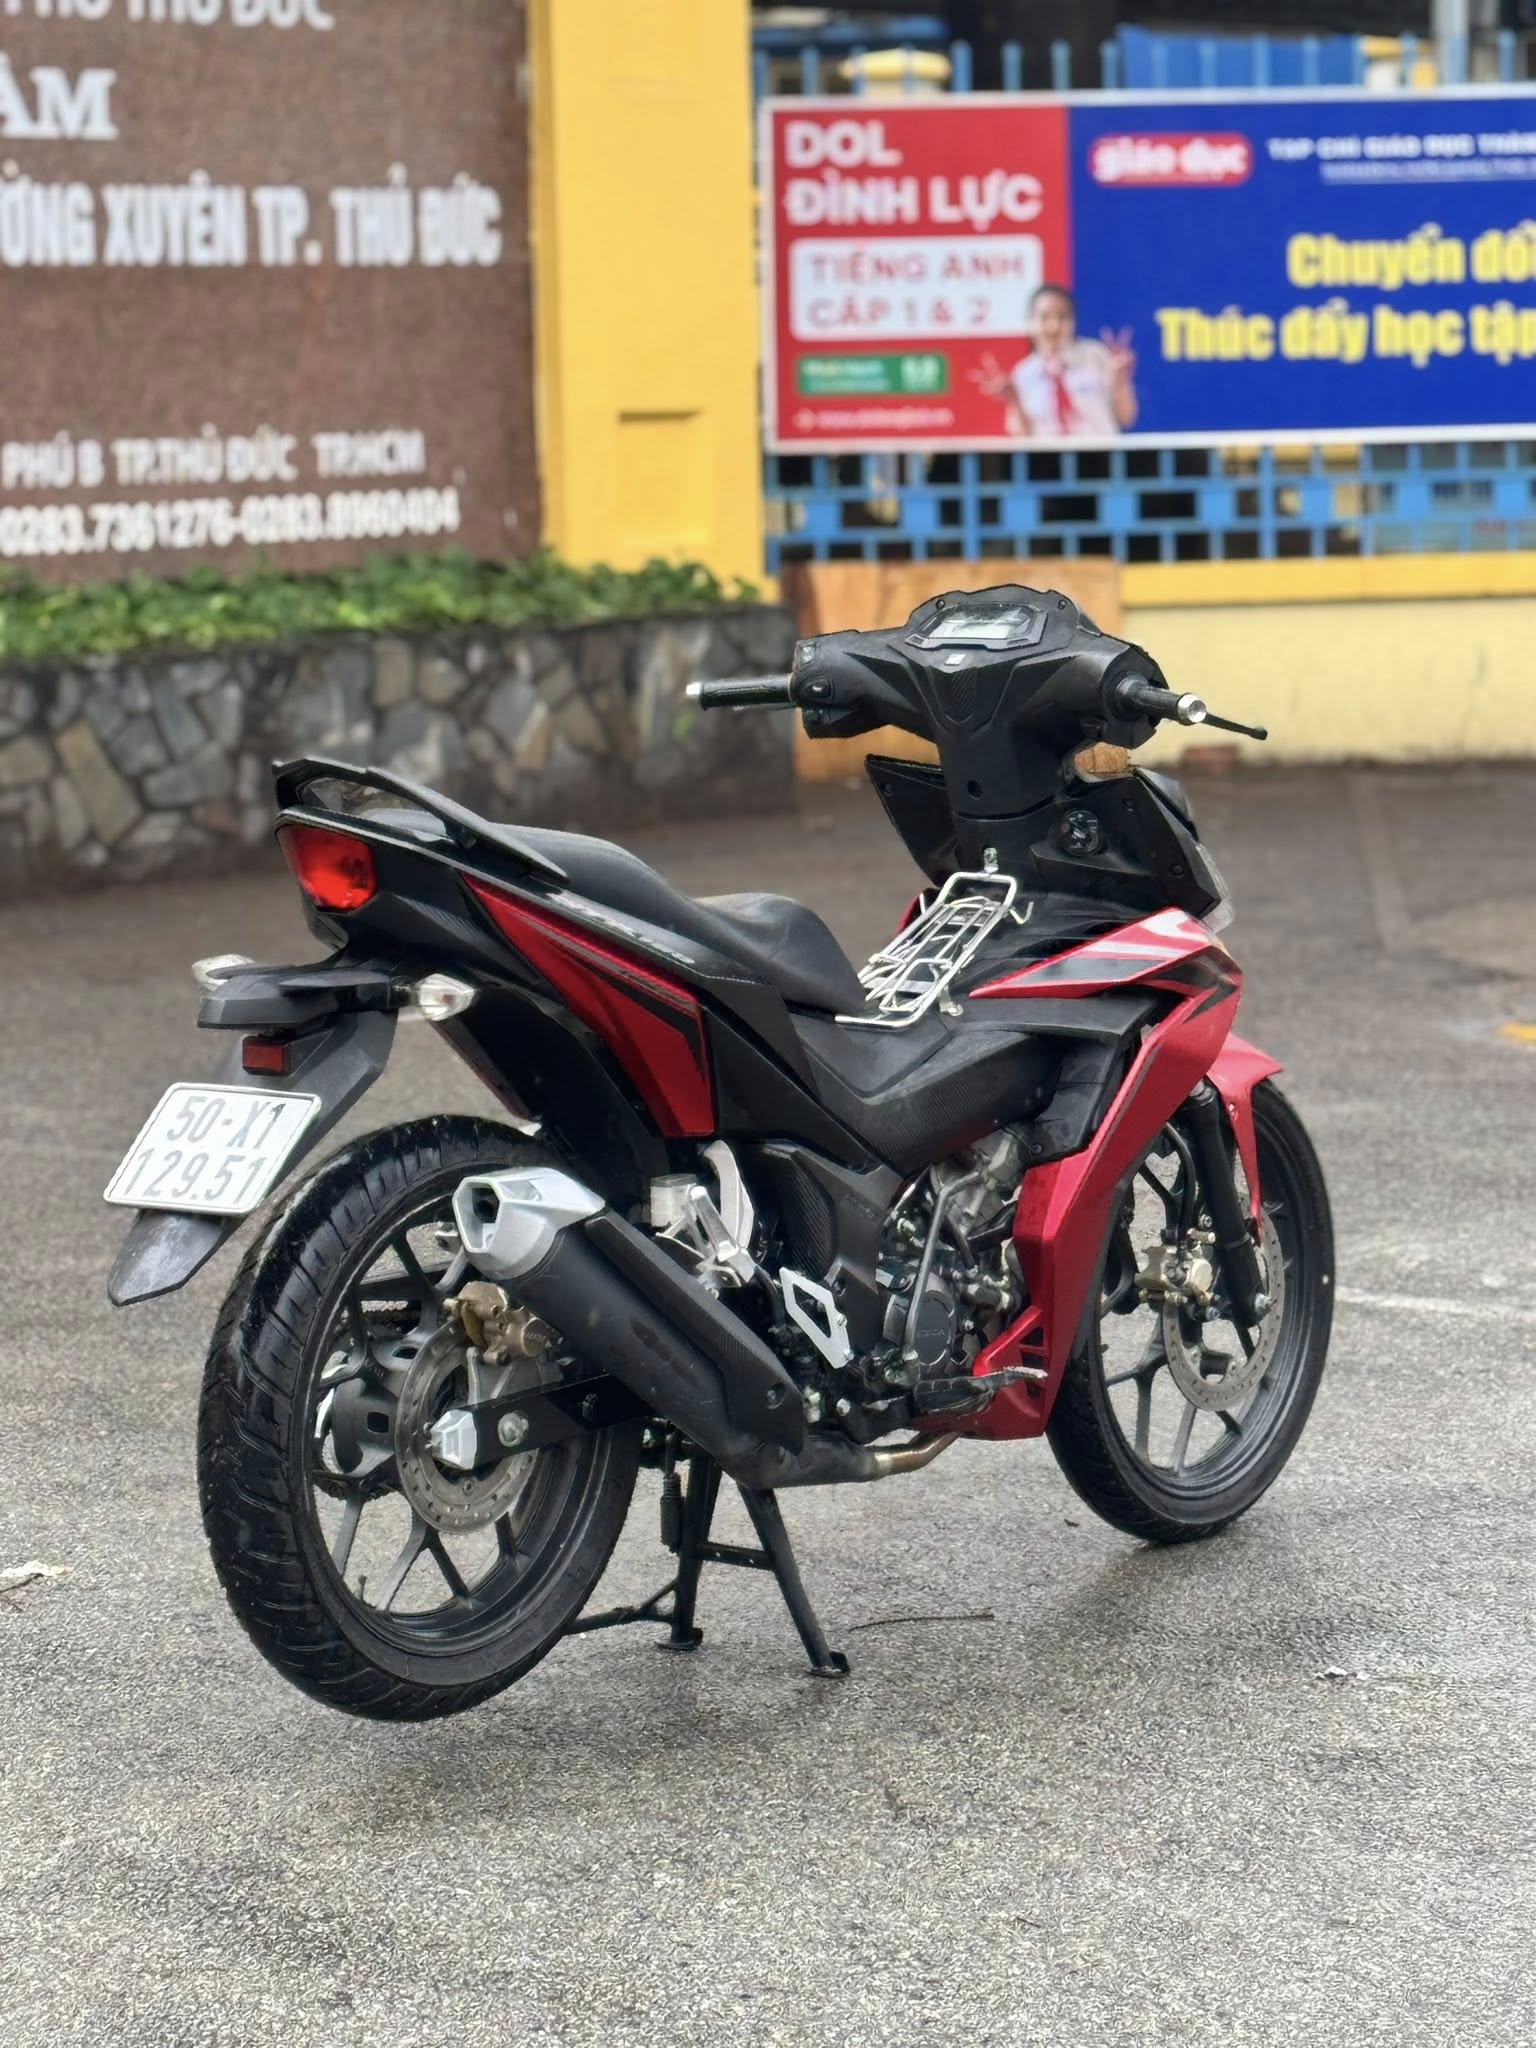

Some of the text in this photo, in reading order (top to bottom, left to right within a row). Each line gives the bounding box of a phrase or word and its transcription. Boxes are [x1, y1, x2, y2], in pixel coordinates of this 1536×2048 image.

[785, 119, 902, 168] DOL
[1093, 136, 1247, 183] giáo dục
[101, 168, 248, 267] XUYÊN
[252, 185, 323, 267] TP.
[330, 161, 414, 266] THỦ
[418, 171, 502, 267] ĐỨC
[783, 168, 1044, 231] ĐÌNH LỰC
[941, 251, 1025, 282] ANH
[1287, 222, 1466, 291] Chuyển
[1155, 304, 1276, 362] Thúc
[1280, 297, 1369, 365] đẩy
[1373, 304, 1465, 369] học
[167, 1095, 286, 1149] 50-X1
[123, 1148, 267, 1204] 129.51
